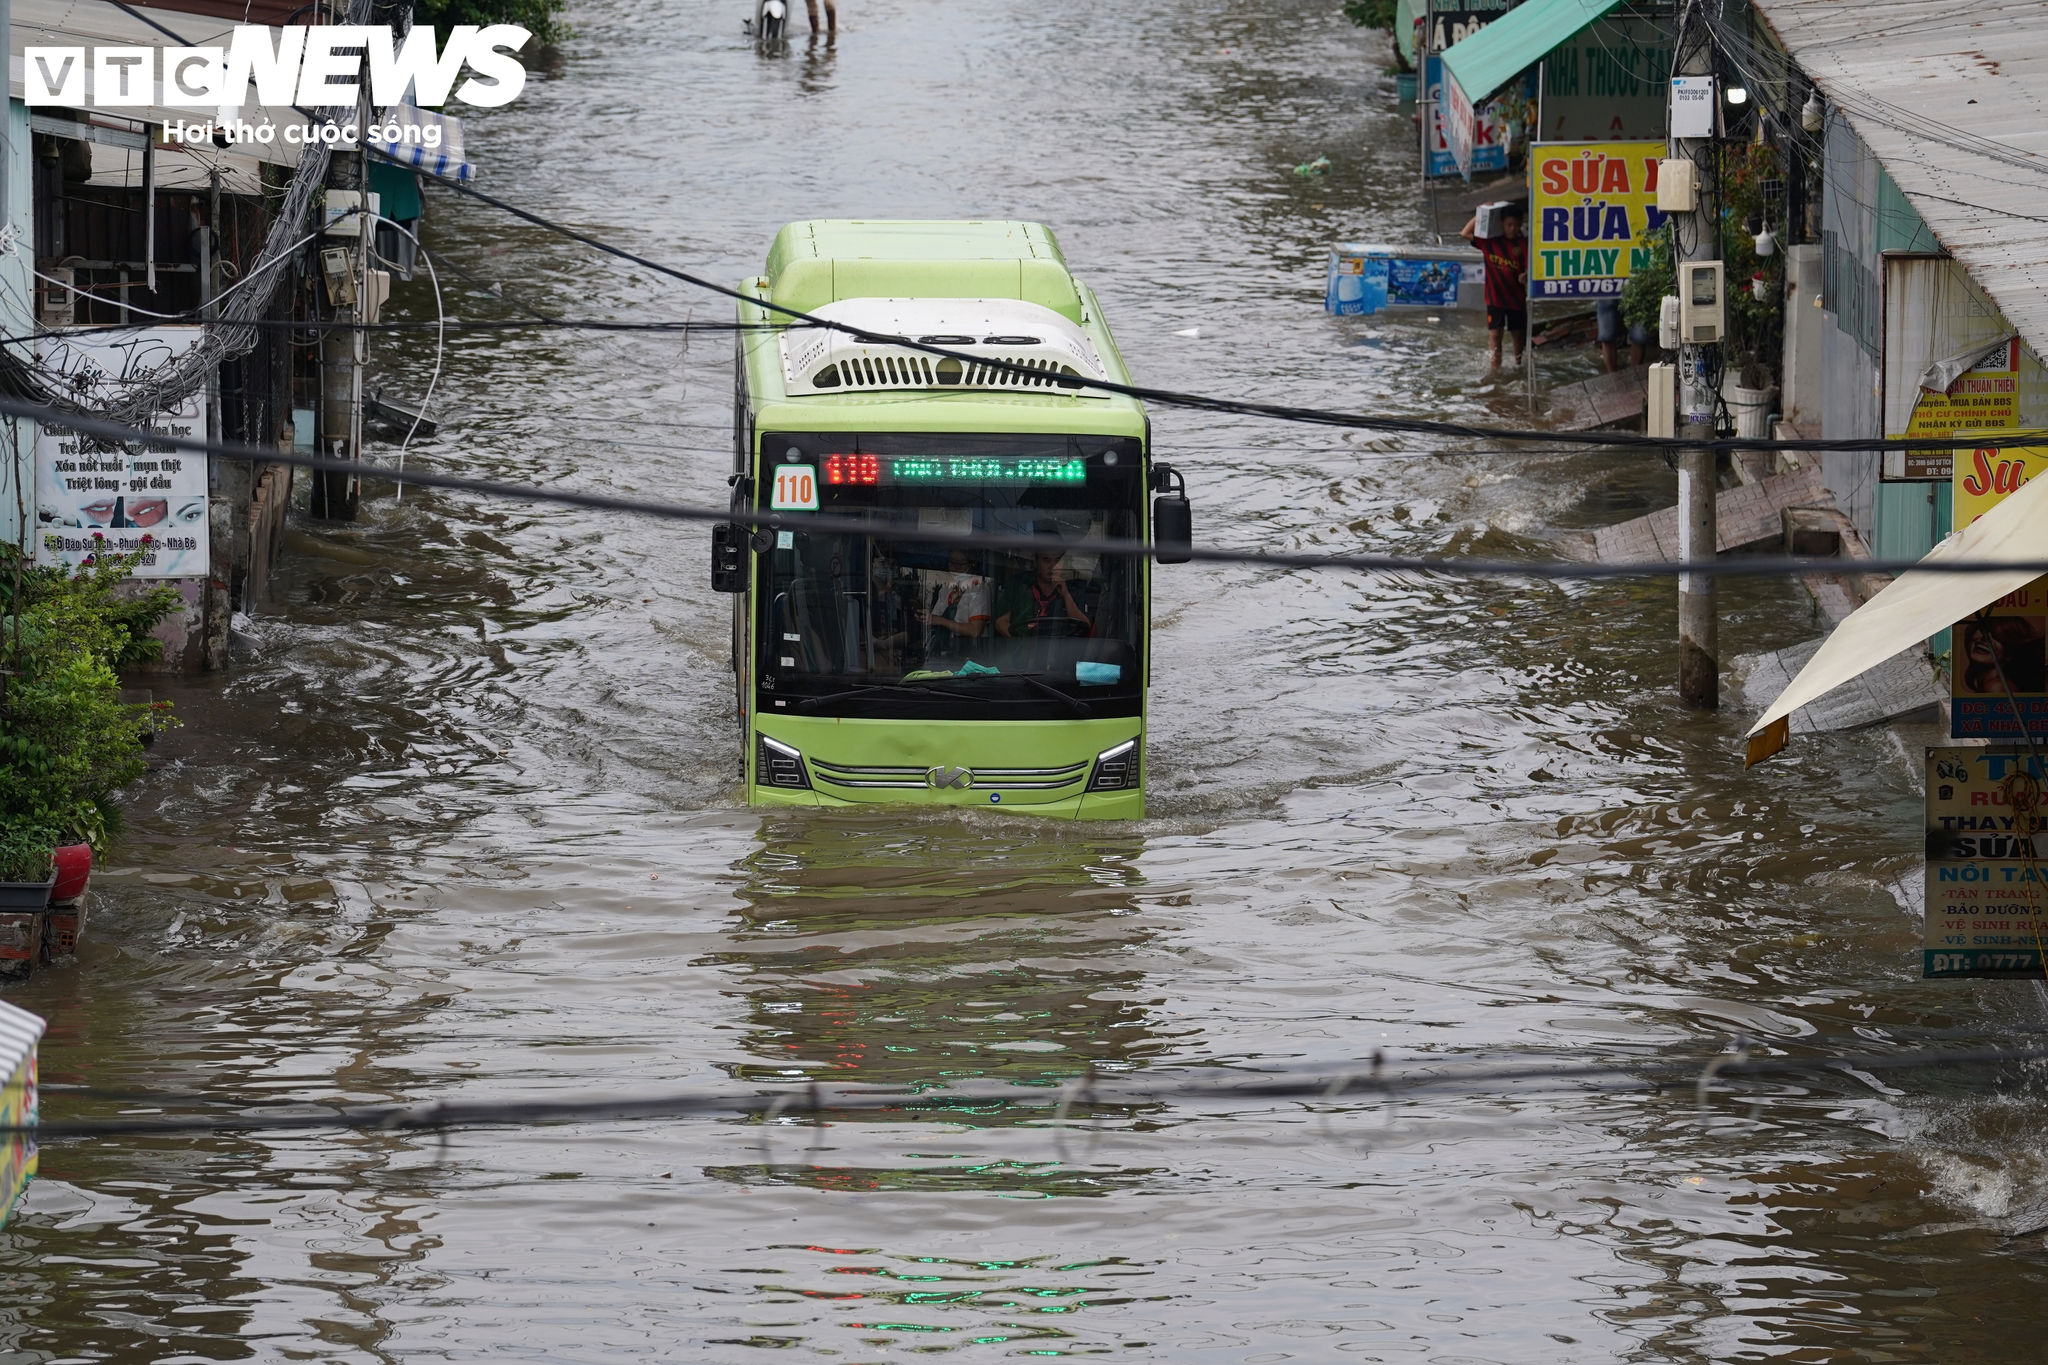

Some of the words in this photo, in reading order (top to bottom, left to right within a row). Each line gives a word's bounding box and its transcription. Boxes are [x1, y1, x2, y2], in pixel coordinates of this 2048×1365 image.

[1541, 151, 1631, 195] SỬA
[1542, 197, 1631, 242] RỬA
[1540, 250, 1622, 277] THAY
[1544, 281, 1573, 293] ĐT:
[1951, 399, 1970, 408] MUA
[1994, 398, 2012, 406] BĐS
[55, 459, 77, 472] Xóa
[777, 475, 811, 503] 110
[1938, 816, 2015, 830] THAY
[1985, 889, 2041, 899] TRANG
[1972, 920, 2010, 929] SINH
